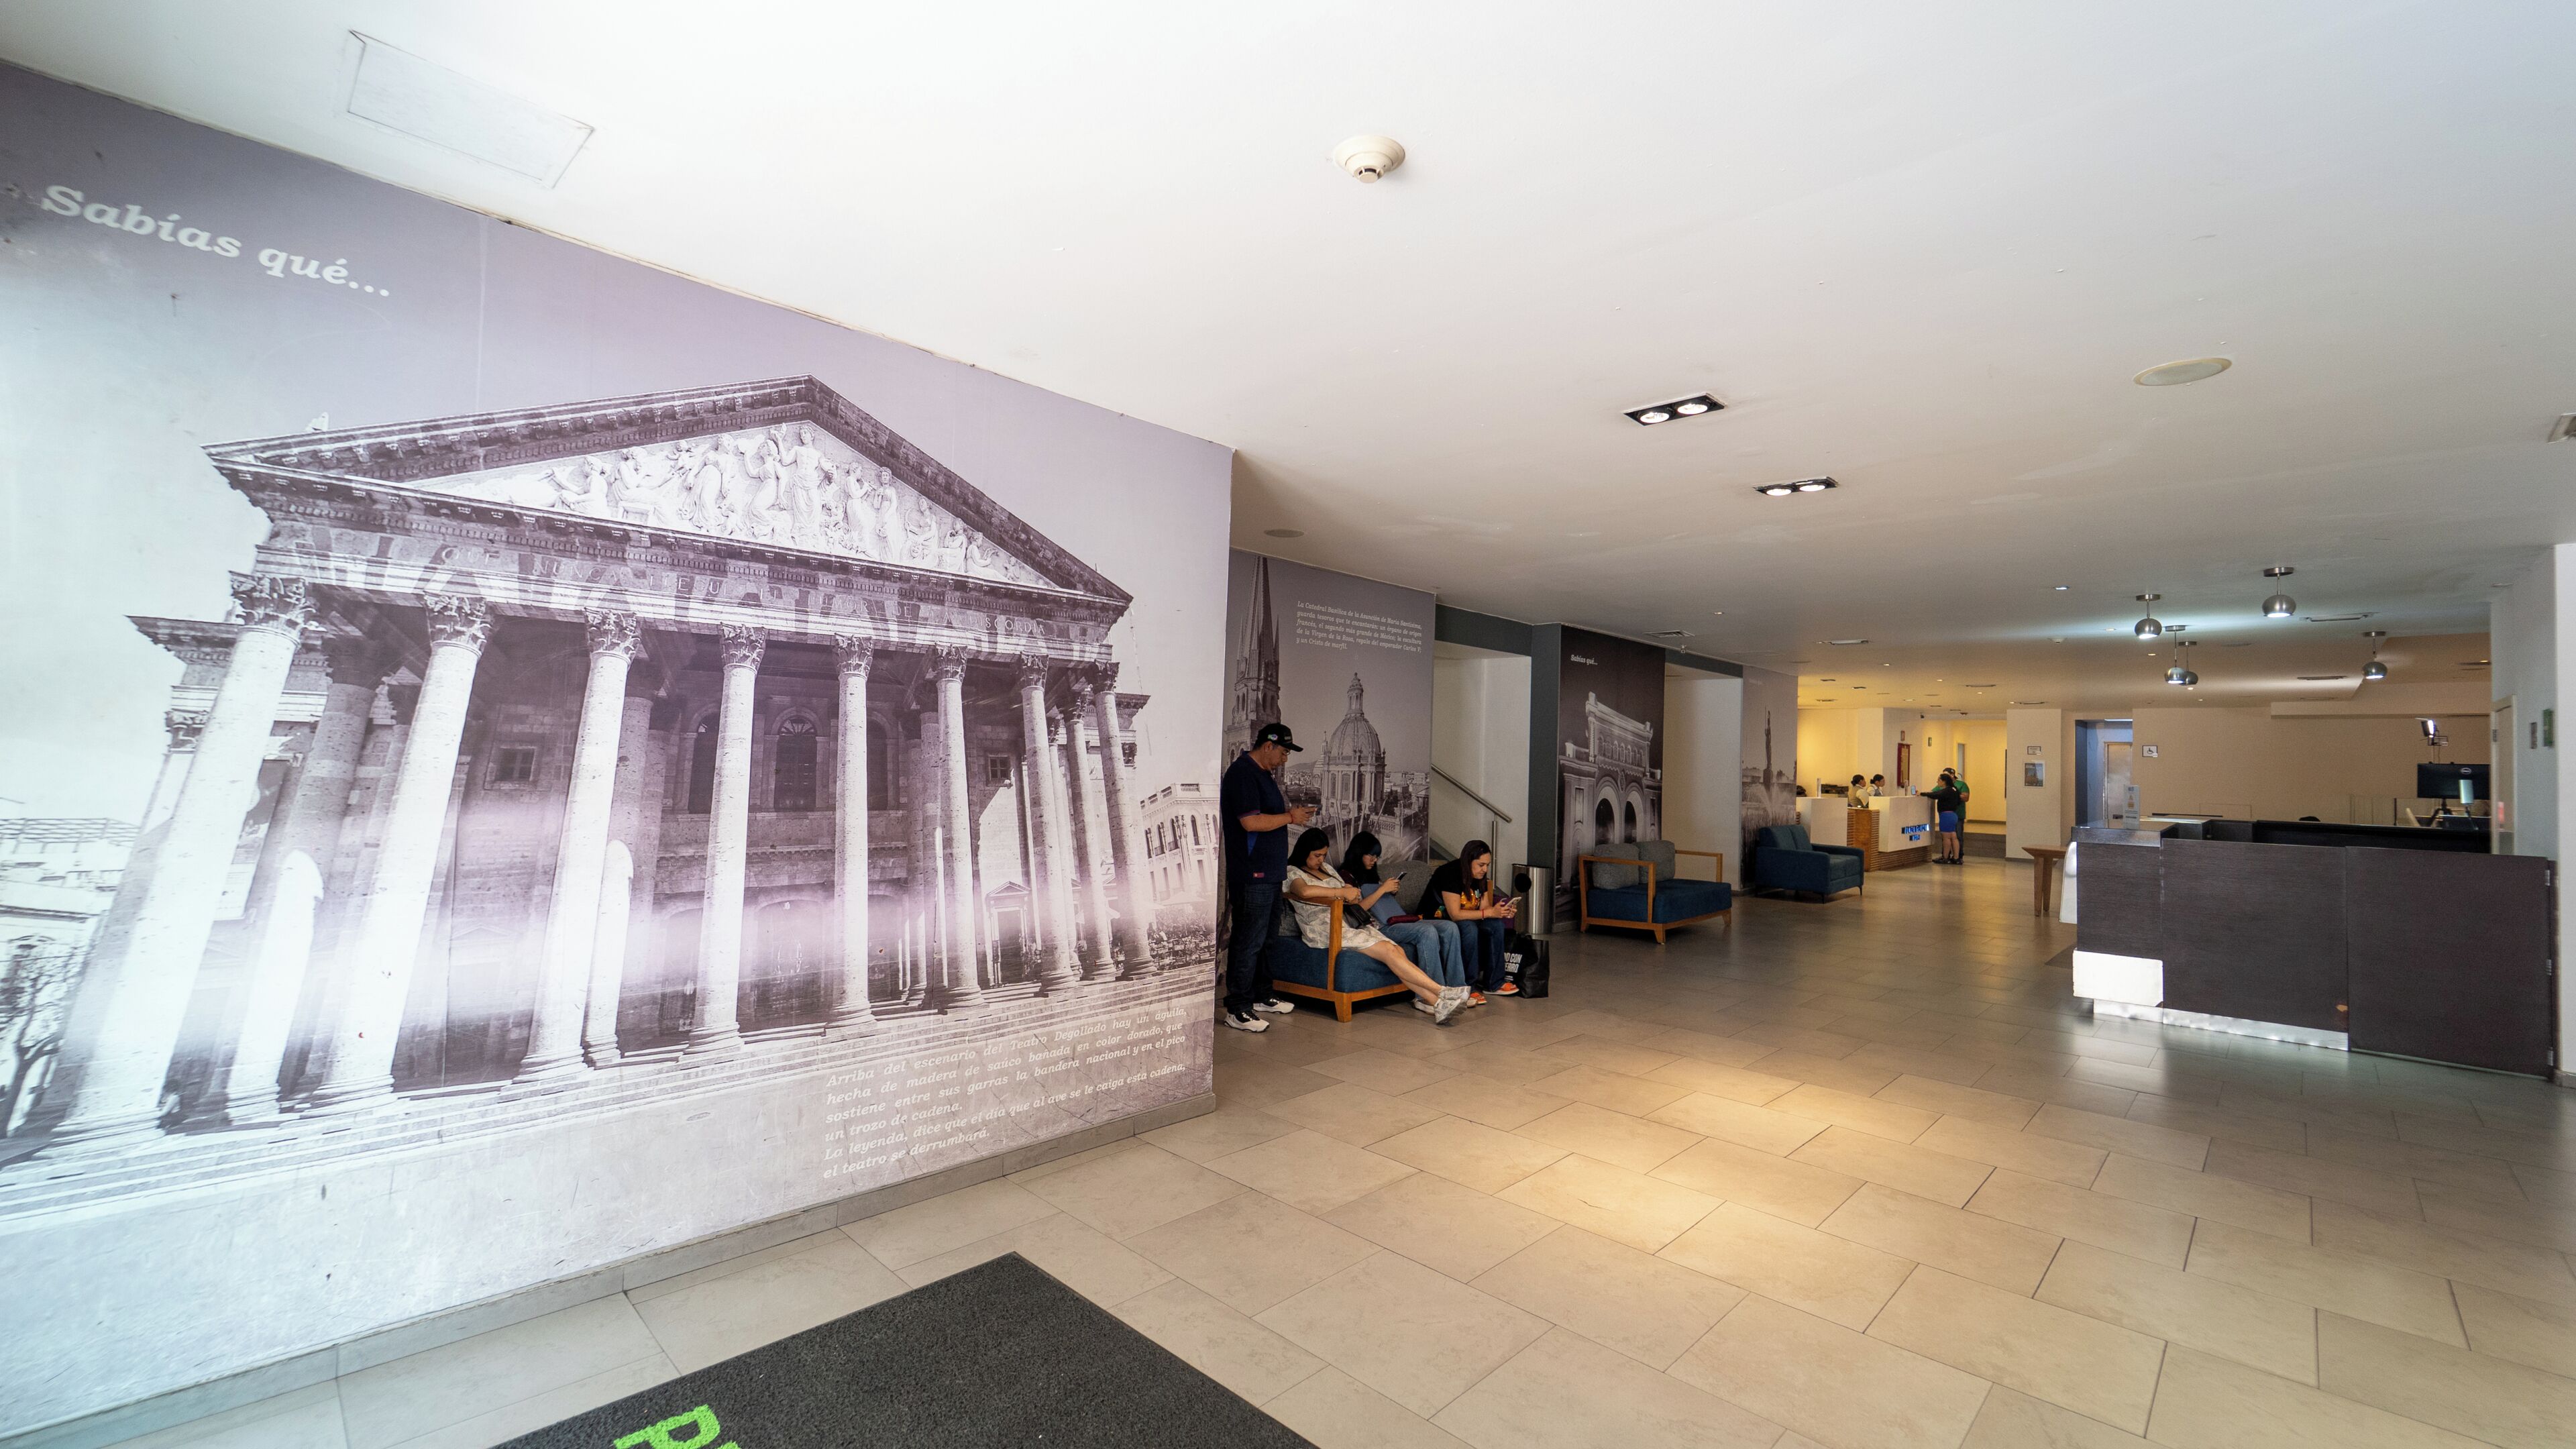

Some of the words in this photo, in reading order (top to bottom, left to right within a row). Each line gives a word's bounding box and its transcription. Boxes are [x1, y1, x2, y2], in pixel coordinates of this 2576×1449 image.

[40, 185, 242, 258] Sabías
[258, 248, 390, 297] qué...
[1305, 602, 1327, 612] Catedral
[1317, 614, 1334, 622] tesoros
[1409, 630, 1422, 638] origen
[1311, 629, 1327, 638] Virgen
[1379, 641, 1402, 649] emperador
[1505, 963, 1519, 973] ERRO
[1510, 953, 1522, 963] CON
[826, 1069, 875, 1087] Arriba
[883, 1061, 907, 1075] del
[914, 1049, 976, 1069] escenario
[983, 1044, 1002, 1056] del
[1010, 1036, 1047, 1051] Teatro
[1055, 1023, 1106, 1041] Degollado
[1113, 1019, 1132, 1029] hay
[1136, 1015, 1150, 1024] un
[1155, 1007, 1187, 1022] águila,
[826, 1087, 871, 1106] hecha
[881, 1081, 898, 1093] de
[906, 1069, 957, 1088] madera
[965, 1065, 980, 1077] de
[987, 1057, 1022, 1071] saúco
[1028, 1046, 1071, 1063] bañada
[1077, 1043, 1090, 1052] en
[1095, 1035, 1122, 1048] color
[1127, 1026, 1163, 1041] dorado,
[1166, 1022, 1183, 1034] que
[826, 1102, 885, 1124] sostiene
[895, 1091, 930, 1108] entre
[938, 1085, 961, 1098] sus
[967, 1076, 1008, 1095] garras
[1016, 1071, 1027, 1081] la
[1034, 1059, 1079, 1077] bandera
[1086, 1046, 1130, 1065] nacional
[1132, 1046, 1139, 1056] y
[1141, 1042, 1153, 1051] en
[1155, 1038, 1165, 1048] el
[1165, 1035, 1185, 1049] pico
[824, 1148, 843, 1161] La
[849, 1132, 908, 1155] leyenda,
[913, 1122, 941, 1138] dice
[945, 1117, 967, 1132] que
[971, 1113, 983, 1124] el
[985, 1108, 1006, 1120] día
[1009, 1102, 1030, 1116] que
[1033, 1096, 1045, 1108] al
[1048, 1093, 1067, 1104] ave
[1069, 1088, 1081, 1098] se
[1084, 1084, 1093, 1094] le
[1096, 1077, 1125, 1092] caiga
[1127, 1071, 1147, 1084] esta
[1150, 1063, 1186, 1078] cadena,
[824, 1129, 845, 1142] un
[849, 1120, 886, 1136] trozo
[890, 1114, 908, 1126] de
[912, 1101, 963, 1121] cadena.
[823, 1166, 839, 1179] el
[842, 1154, 888, 1174] teatro
[890, 1150, 906, 1162] se
[910, 1126, 990, 1157] derrumbará.
